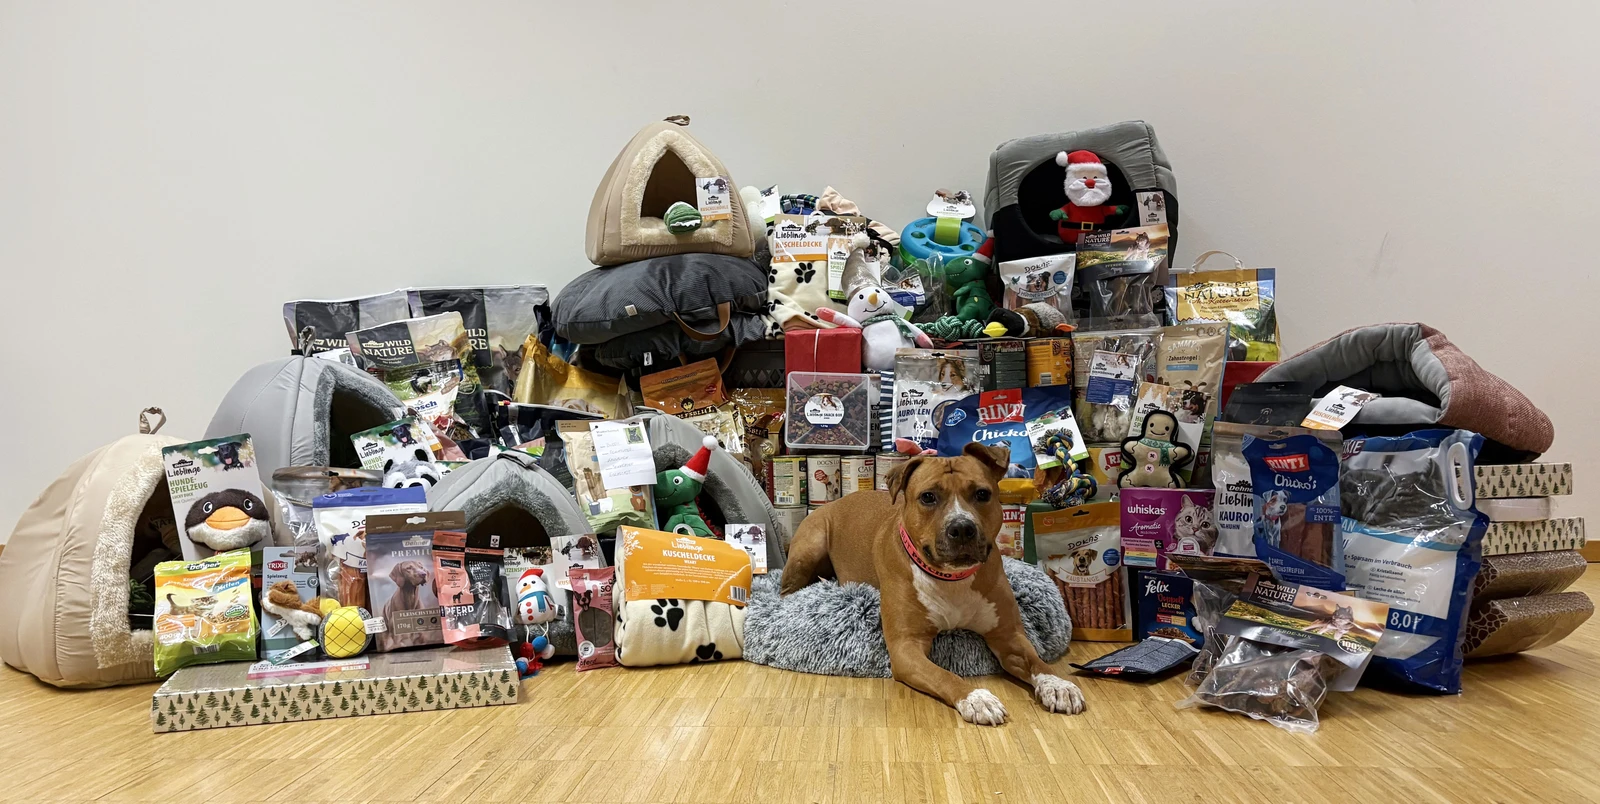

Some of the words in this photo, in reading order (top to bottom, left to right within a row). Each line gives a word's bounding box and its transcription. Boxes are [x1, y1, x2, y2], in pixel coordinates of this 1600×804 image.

[775, 232, 807, 240] Lieblinge
[1184, 287, 1252, 301] NATURE
[466, 328, 486, 337] ILD
[384, 339, 411, 347] WILD
[363, 346, 414, 357] NATURE
[897, 409, 930, 418] AUROLEN
[976, 403, 1027, 421] RINTI
[972, 429, 1028, 442] Chicko
[359, 446, 385, 458] Lieblinge
[1269, 456, 1306, 470] RINTI
[167, 466, 201, 477] Lieblinge
[169, 476, 197, 488] HUNDE-
[171, 482, 209, 494] SPIELZEUG
[1127, 504, 1166, 515] whiskas
[1129, 522, 1161, 537] Aromatic
[671, 540, 704, 552] Lieblinge
[1067, 535, 1100, 551] DOKAS
[662, 549, 716, 562] KUSCHELDECKE
[912, 551, 952, 578] PSYCHO
[1350, 554, 1374, 564] Sparsam
[1382, 559, 1413, 570] Verbrauch
[1145, 580, 1170, 597] felix
[1254, 586, 1295, 603] NATURE
[1276, 585, 1297, 594] WILD
[446, 605, 475, 615] PFERD
[1161, 602, 1181, 610] LECKER
[1390, 611, 1411, 629] 8,0
